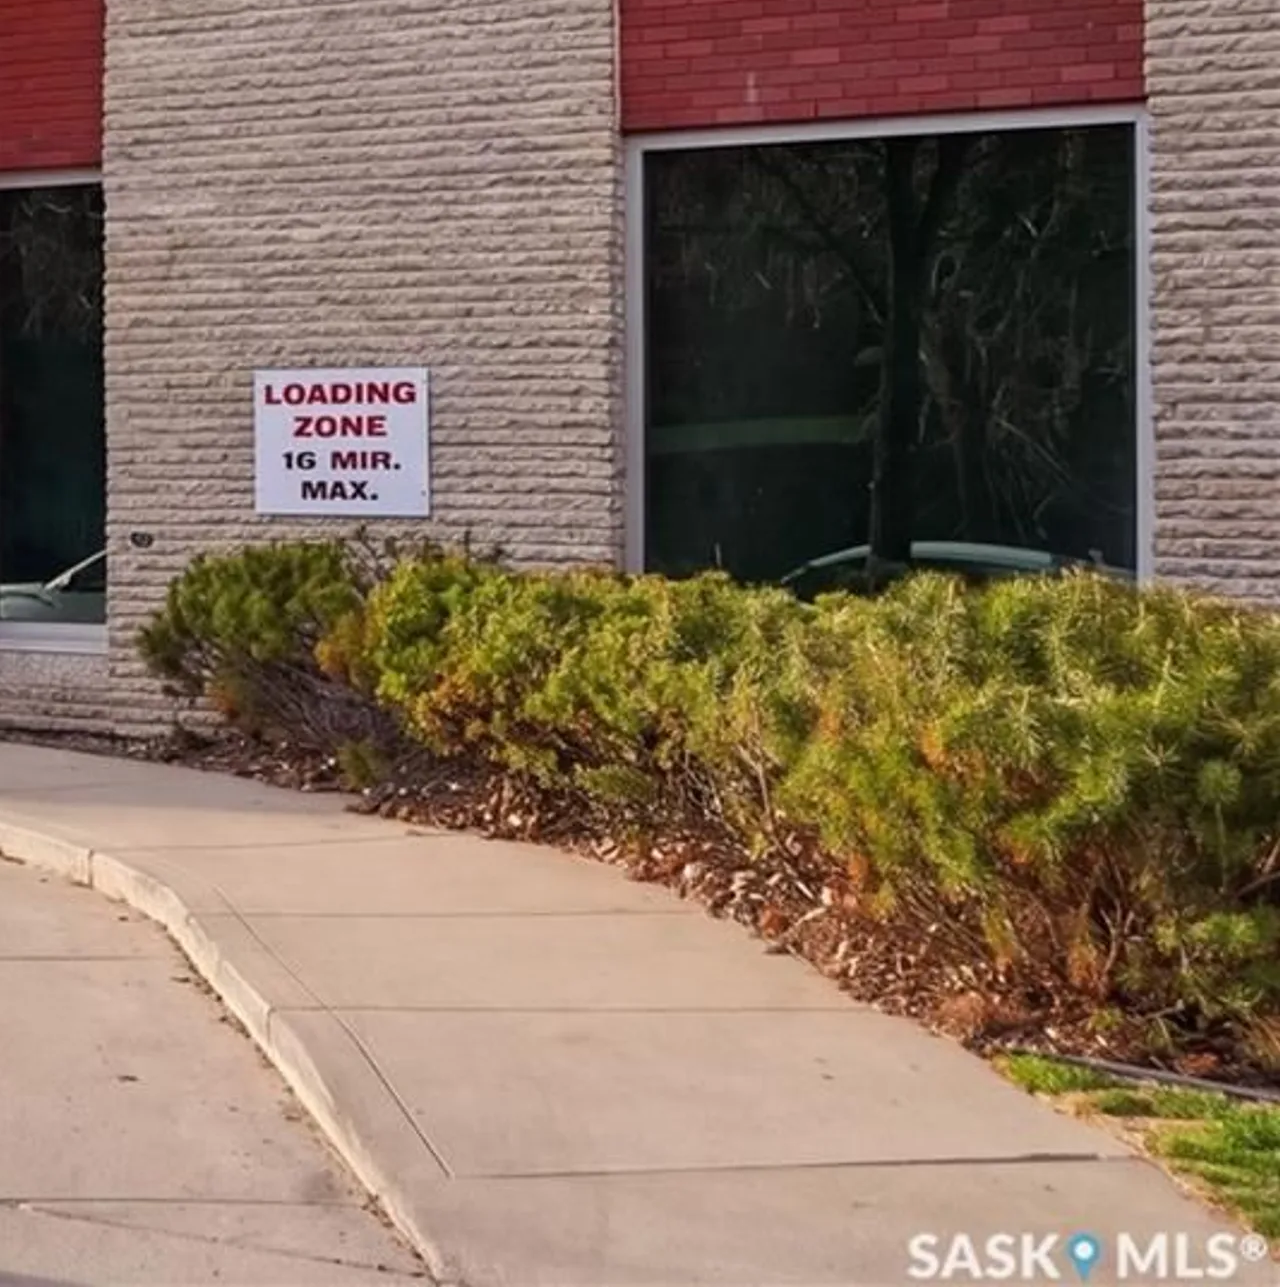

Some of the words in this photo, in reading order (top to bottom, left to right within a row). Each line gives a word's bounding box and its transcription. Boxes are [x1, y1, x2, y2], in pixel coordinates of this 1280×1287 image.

[264, 381, 417, 405] LOADING
[293, 415, 388, 438] ZONE
[301, 480, 379, 501] MAX.
